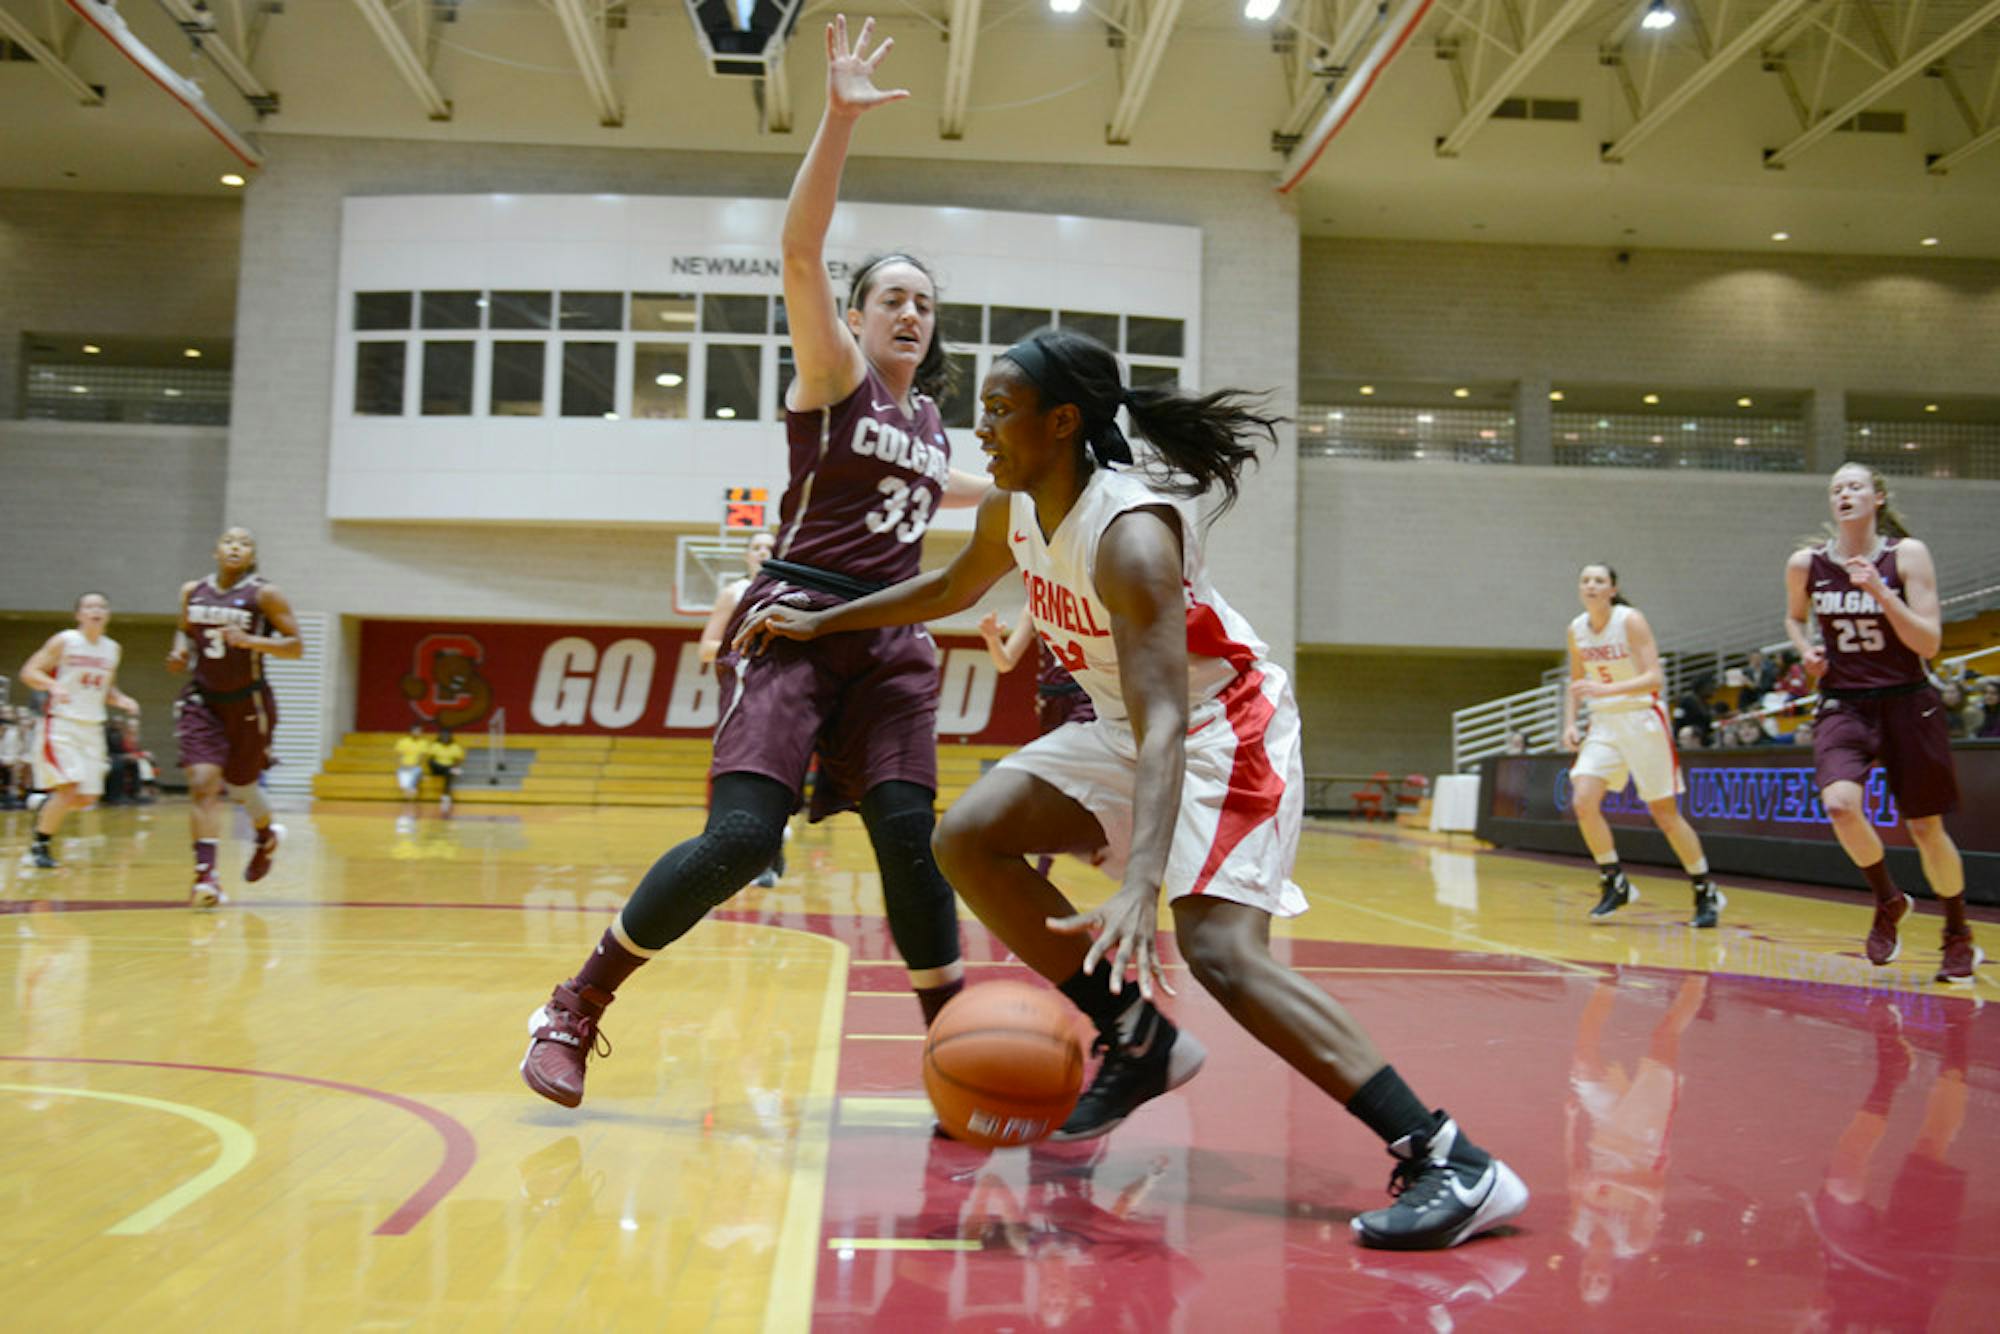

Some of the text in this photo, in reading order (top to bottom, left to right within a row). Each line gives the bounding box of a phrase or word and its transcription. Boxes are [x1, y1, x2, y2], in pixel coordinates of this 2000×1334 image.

[671, 256, 780, 276] NEWMAN
[851, 416, 949, 491] COLGA
[865, 476, 932, 543] 33
[1811, 591, 1884, 615] COLGA
[203, 628, 226, 659] 3
[1832, 619, 1885, 652] 25
[530, 636, 656, 728] GO
[1597, 664, 1616, 685] 5
